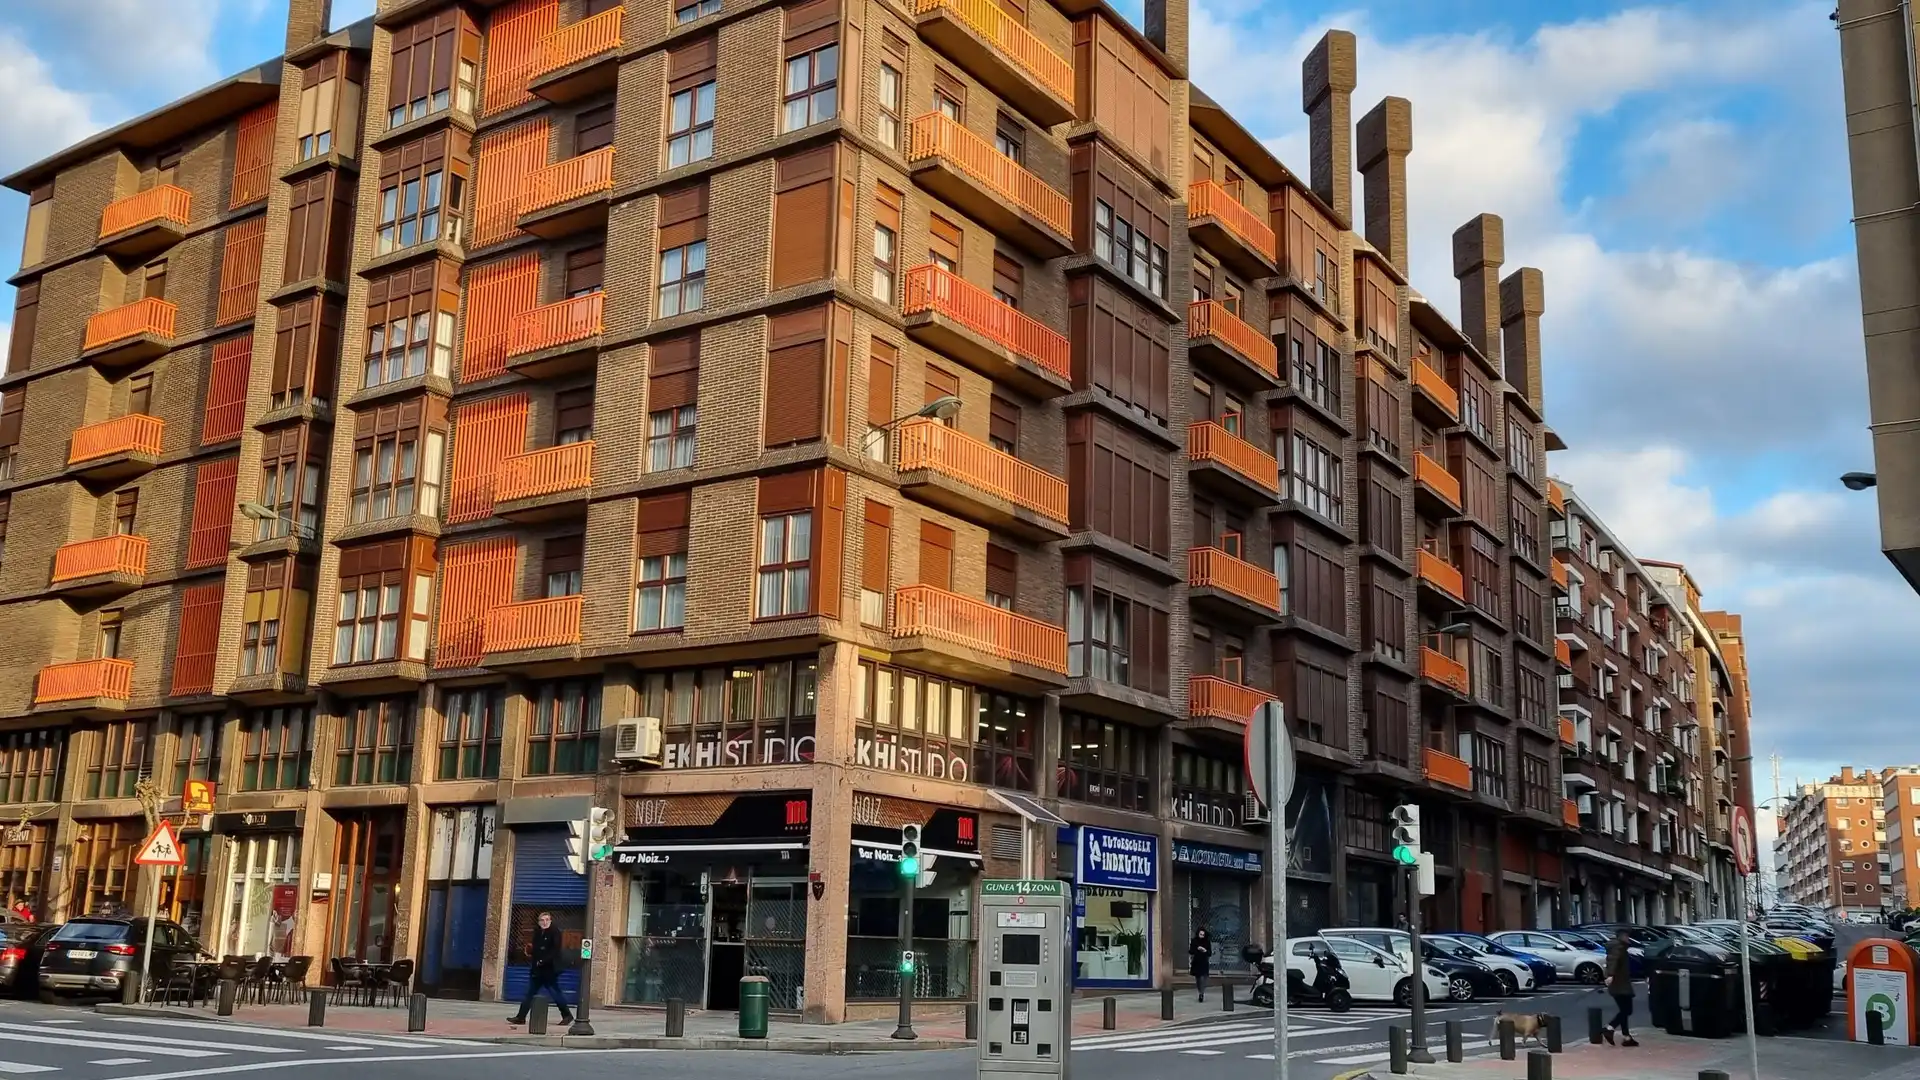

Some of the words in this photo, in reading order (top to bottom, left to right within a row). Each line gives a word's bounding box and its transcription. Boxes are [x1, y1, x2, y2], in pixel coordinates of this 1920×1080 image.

[635, 800, 666, 825] NOIZ
[853, 795, 881, 824] NOIZ
[619, 853, 636, 863] Bar
[858, 847, 873, 859] Bar
[986, 883, 1015, 892] GUNEA
[1016, 882, 1030, 894] 14
[1031, 884, 1056, 892] ZONA
